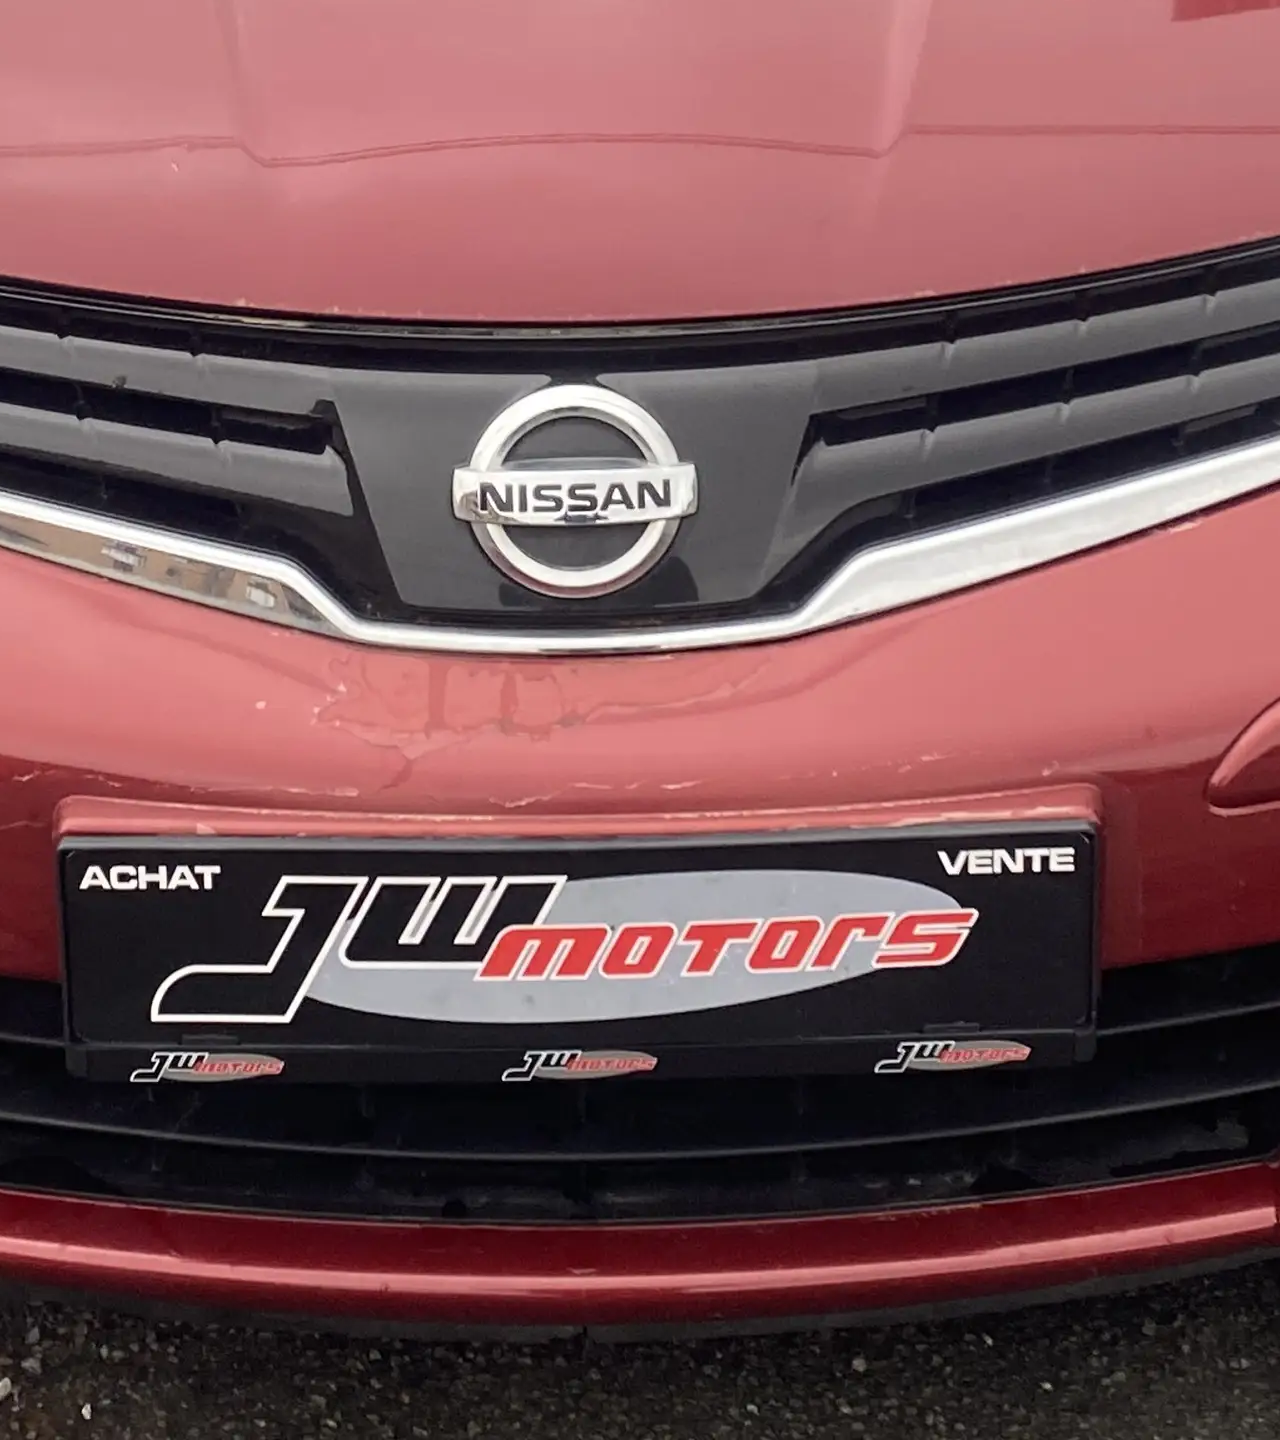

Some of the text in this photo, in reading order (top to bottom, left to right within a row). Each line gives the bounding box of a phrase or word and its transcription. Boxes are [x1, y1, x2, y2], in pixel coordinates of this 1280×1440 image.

[477, 478, 673, 513] NISSAN
[937, 846, 1076, 876] VENTE
[78, 864, 221, 891] ACHAT
